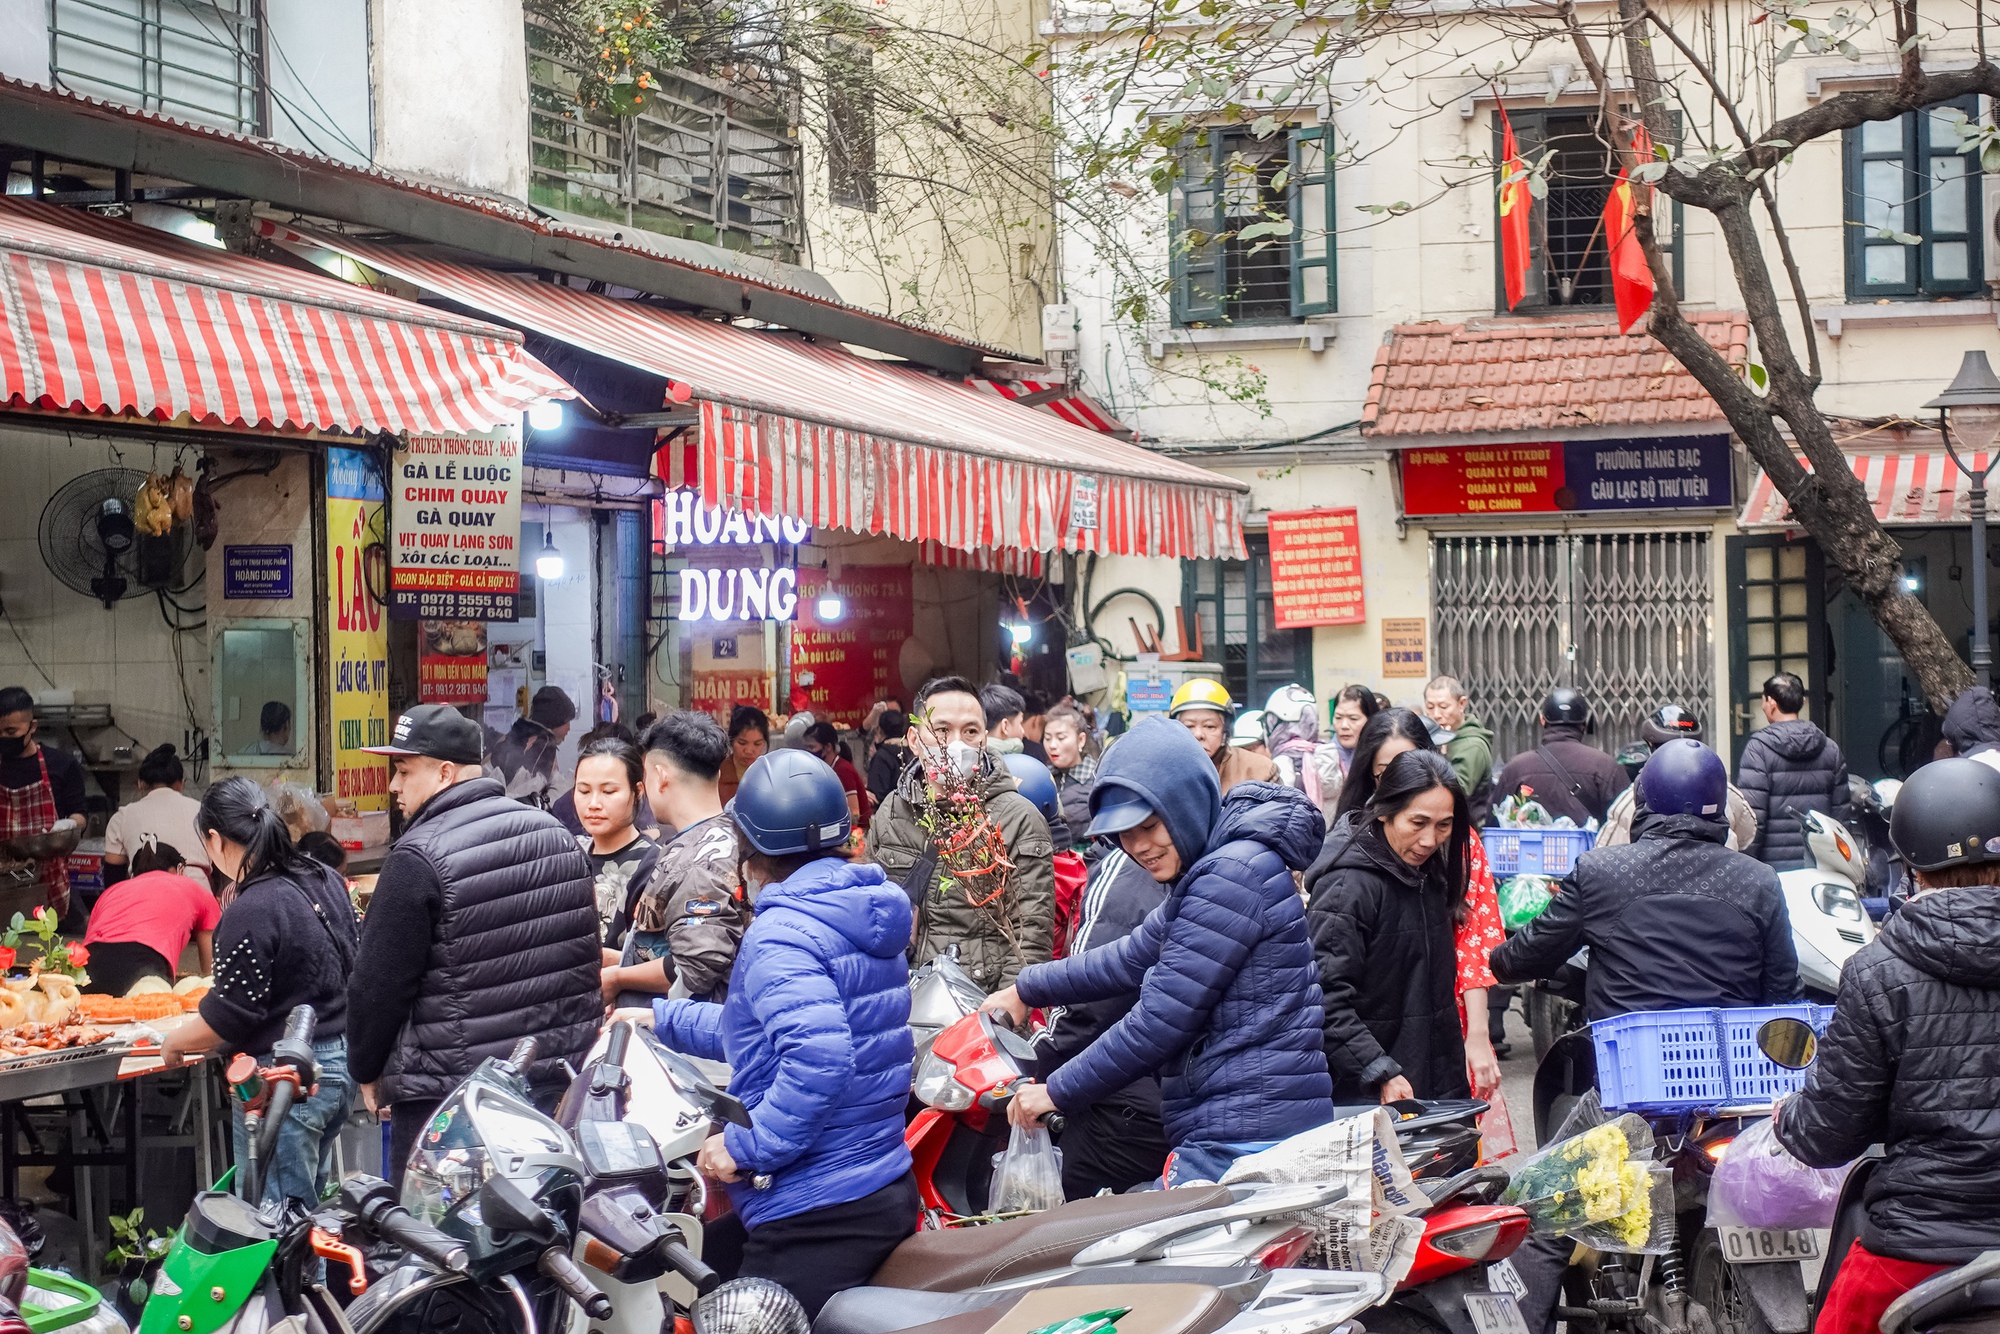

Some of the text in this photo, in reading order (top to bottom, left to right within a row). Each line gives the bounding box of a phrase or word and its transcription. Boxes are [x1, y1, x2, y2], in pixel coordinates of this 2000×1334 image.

[444, 433, 470, 455] THỐNG
[472, 440, 494, 456] CHAY
[500, 436, 517, 461] MẶN
[1464, 447, 1510, 463] QUẢN LÝ
[1595, 446, 1701, 472] PHƯỜNG HÀNG BẠC
[403, 460, 511, 485] GÀ LỄ LUỘC
[1466, 464, 1496, 479] QUẢN
[1497, 465, 1510, 478] LÝ
[1531, 465, 1548, 479] THỊ
[405, 487, 508, 505] CHIM QUAY
[1466, 479, 1537, 495] QUẢN LÝ NHÀ
[1591, 474, 1709, 503] CÂU LẠC BỘ THƯ VIỆN
[1467, 496, 1522, 513] ĐỊA CHÍNH
[417, 508, 496, 527] GÀ QUAY
[399, 532, 513, 551] VỊT QUAY LẠNG SƠN
[400, 550, 511, 569] XÔI CÁC LOẠI...
[235, 568, 281, 581] HOÀNG DUNG
[395, 573, 417, 585] NGON
[419, 571, 434, 589] ĐẶC
[436, 571, 454, 589] BIỆT
[460, 572, 474, 587] GIÁ
[487, 575, 503, 591] HỢP
[505, 574, 515, 588] LÝ
[678, 567, 797, 621] DUNG
[798, 579, 815, 599] HỞ
[397, 593, 513, 607] ĐT: 0978 5555 66
[420, 605, 512, 619] 0912 287 640
[336, 646, 352, 694] LẨU
[372, 660, 386, 698] VỊT
[455, 683, 471, 695] 287
[693, 676, 731, 704] HẬN
[368, 705, 385, 747] ẾCH
[1372, 1138, 1394, 1186] nhân
[1341, 1220, 1350, 1244] Hàng
[1371, 1222, 1383, 1240] ong
[1728, 1229, 1812, 1258] 018.48
